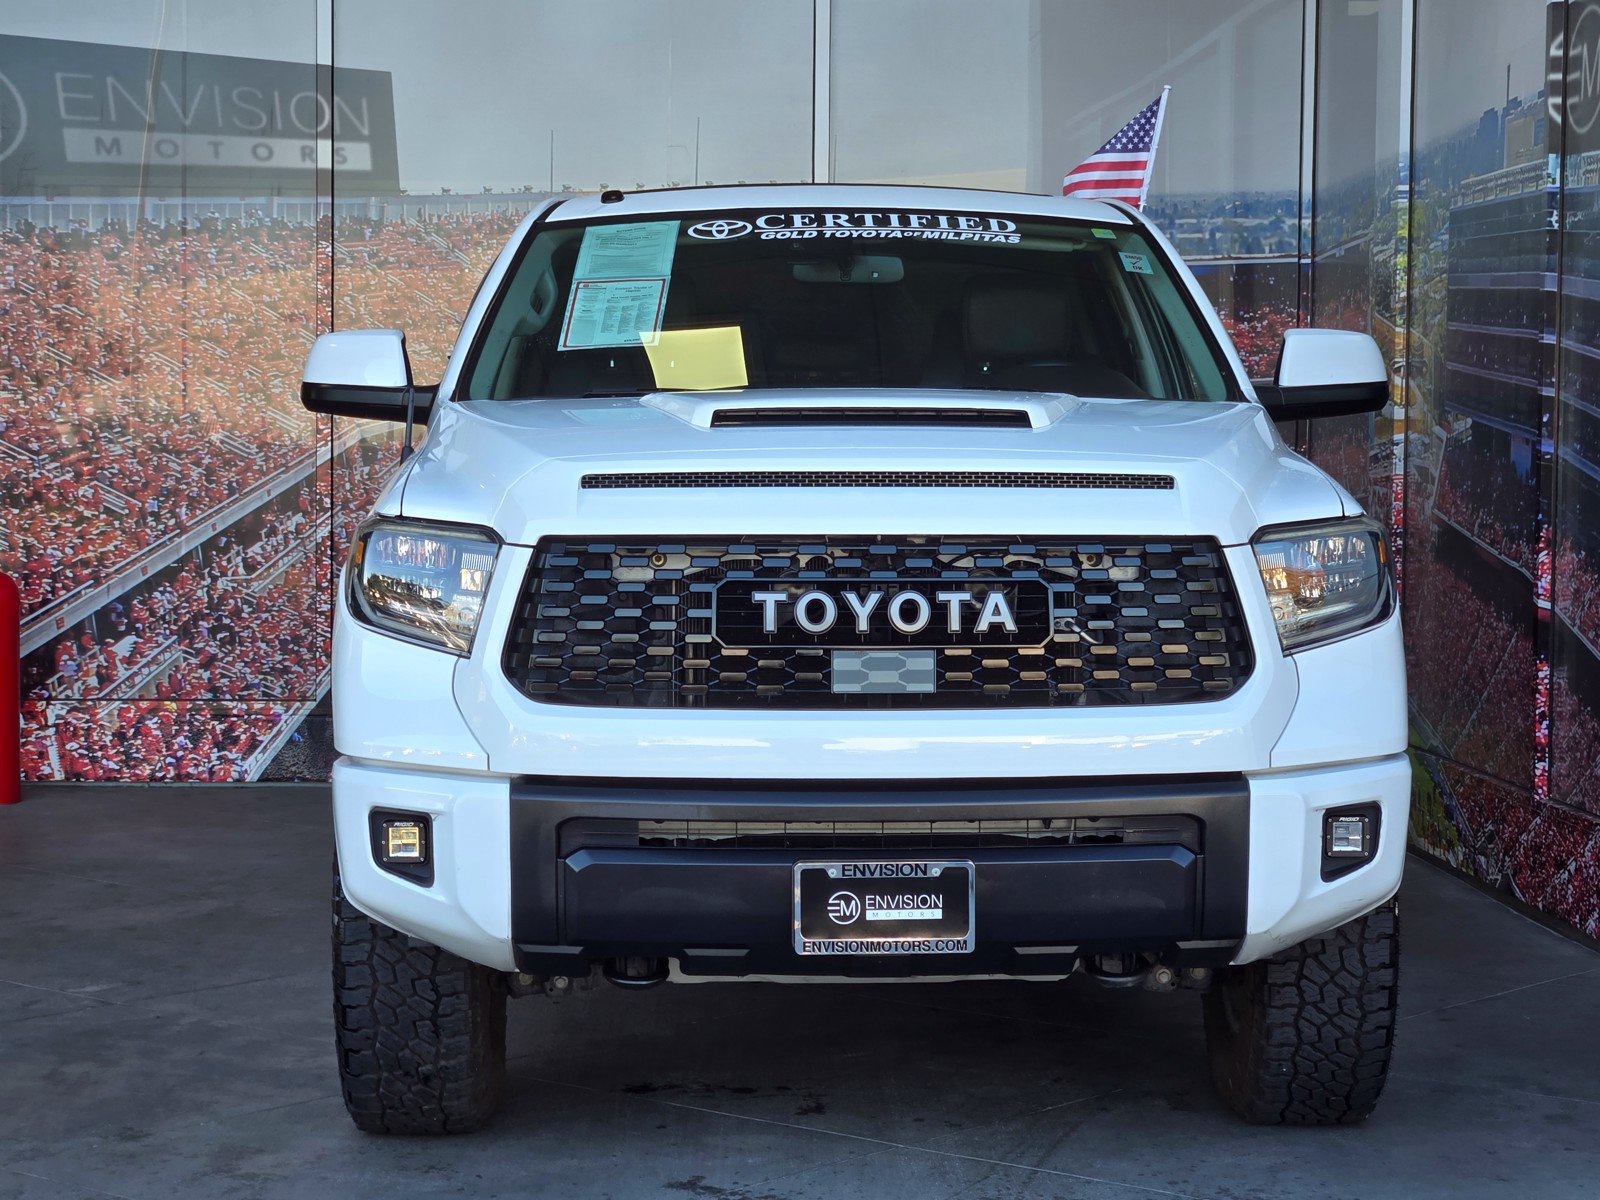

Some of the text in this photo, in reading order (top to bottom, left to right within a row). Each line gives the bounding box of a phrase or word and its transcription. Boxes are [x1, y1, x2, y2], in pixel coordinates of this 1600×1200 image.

[54, 72, 371, 136] ENVISION
[94, 137, 349, 165] MOTORS
[756, 213, 1017, 233] CERTIFIED
[760, 230, 818, 240] GOLD
[822, 230, 902, 239] TOYOTA
[922, 231, 1022, 244] MILPITAS
[752, 590, 1018, 635] TOYOTA
[841, 863, 928, 877] ENVISION
[865, 894, 943, 909] ENVISION
[802, 939, 968, 953] ENVISIONMOTORS.COM
